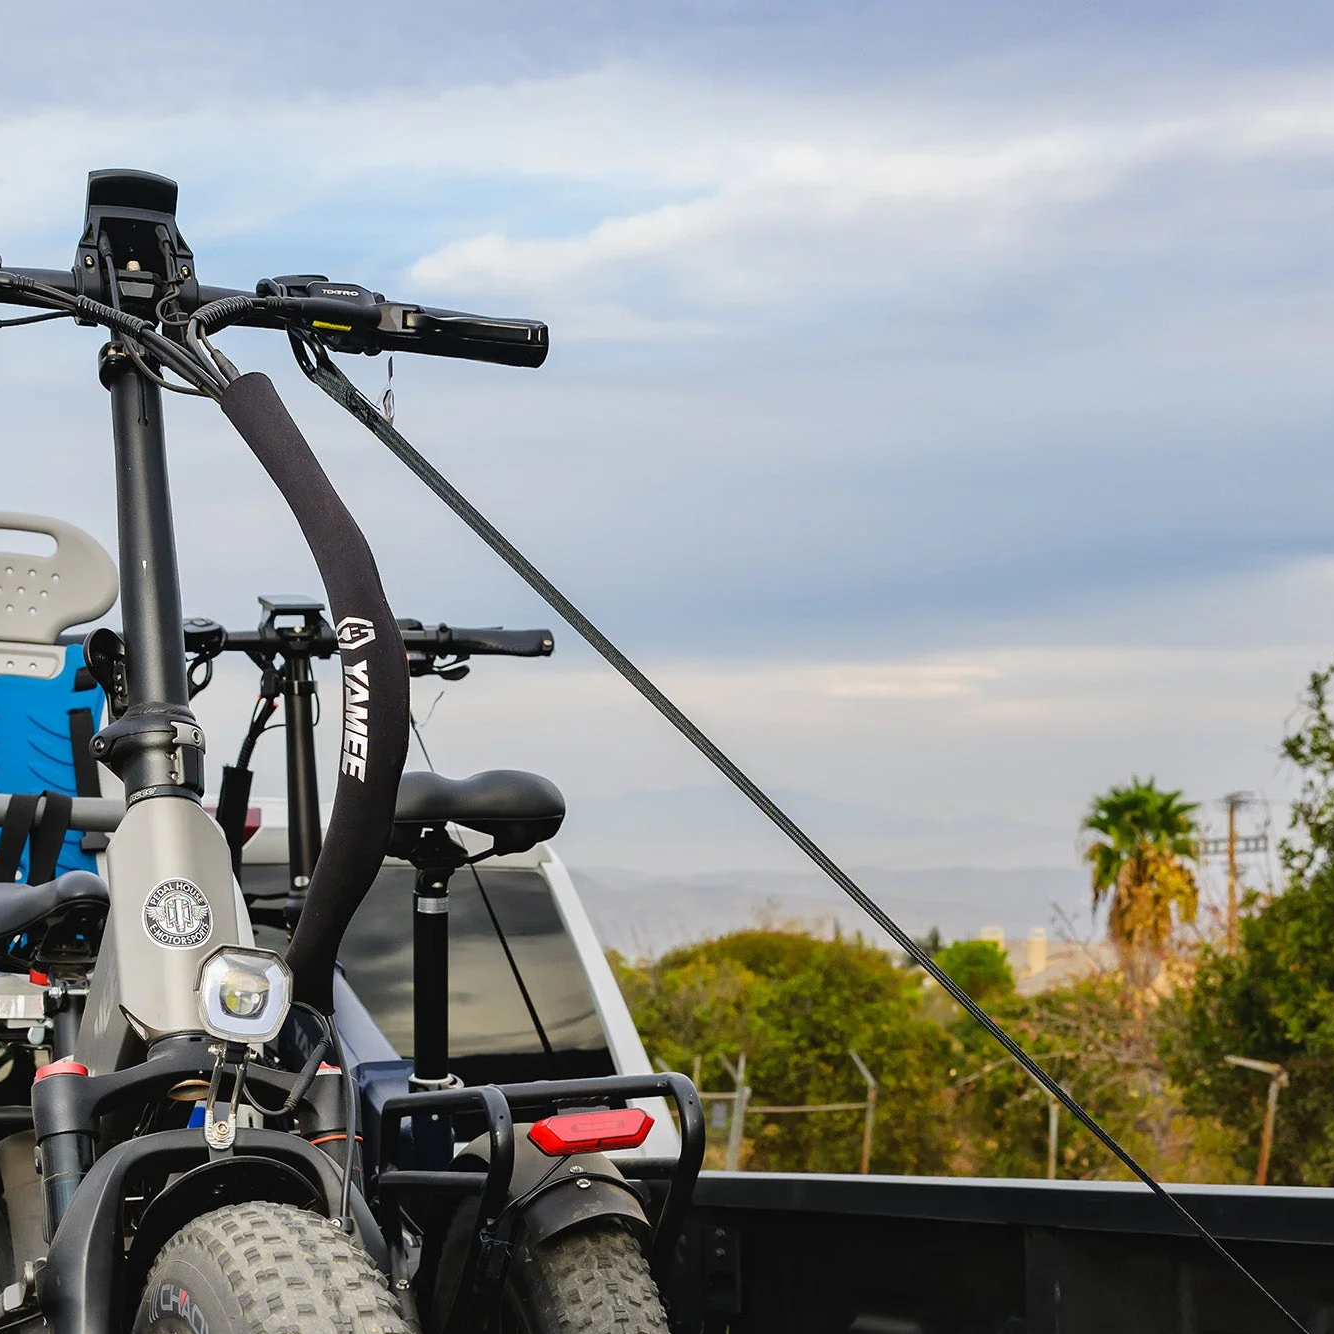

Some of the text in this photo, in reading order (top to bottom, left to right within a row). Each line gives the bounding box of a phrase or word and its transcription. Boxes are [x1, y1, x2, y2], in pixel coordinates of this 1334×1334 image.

[321, 288, 359, 297] TEKTRO
[341, 659, 370, 783] YAMEE
[150, 882, 204, 905] PEDAL HOUSE
[150, 922, 209, 945] E-MOTORSPORTS
